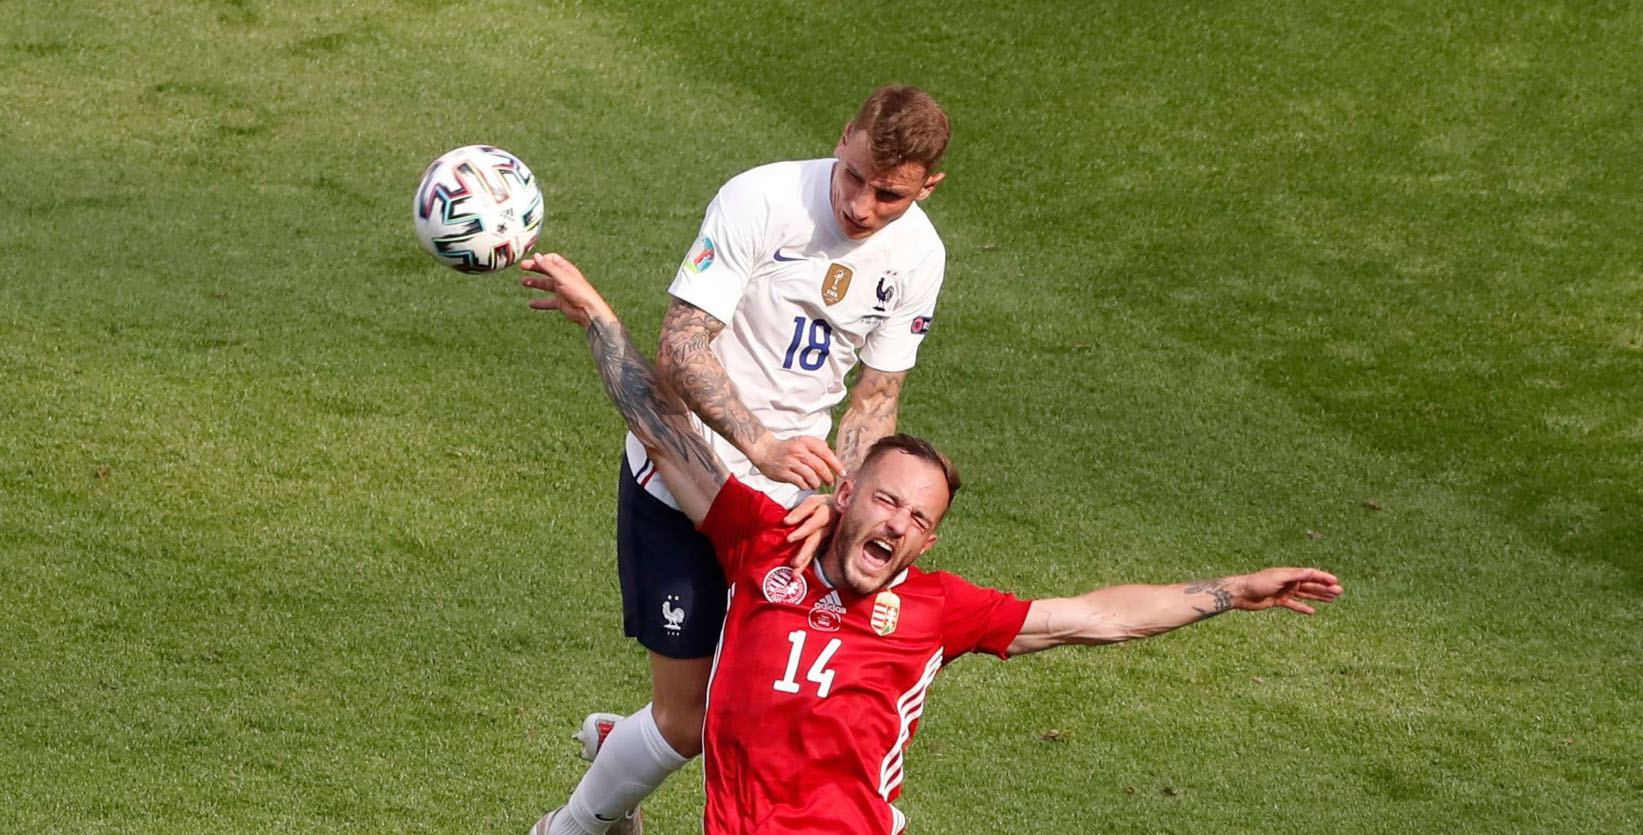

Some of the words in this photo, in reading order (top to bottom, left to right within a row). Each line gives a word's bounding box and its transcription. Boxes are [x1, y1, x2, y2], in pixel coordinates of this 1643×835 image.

[782, 316, 832, 371] 18
[814, 602, 847, 614] adidas
[773, 630, 842, 698] 14
